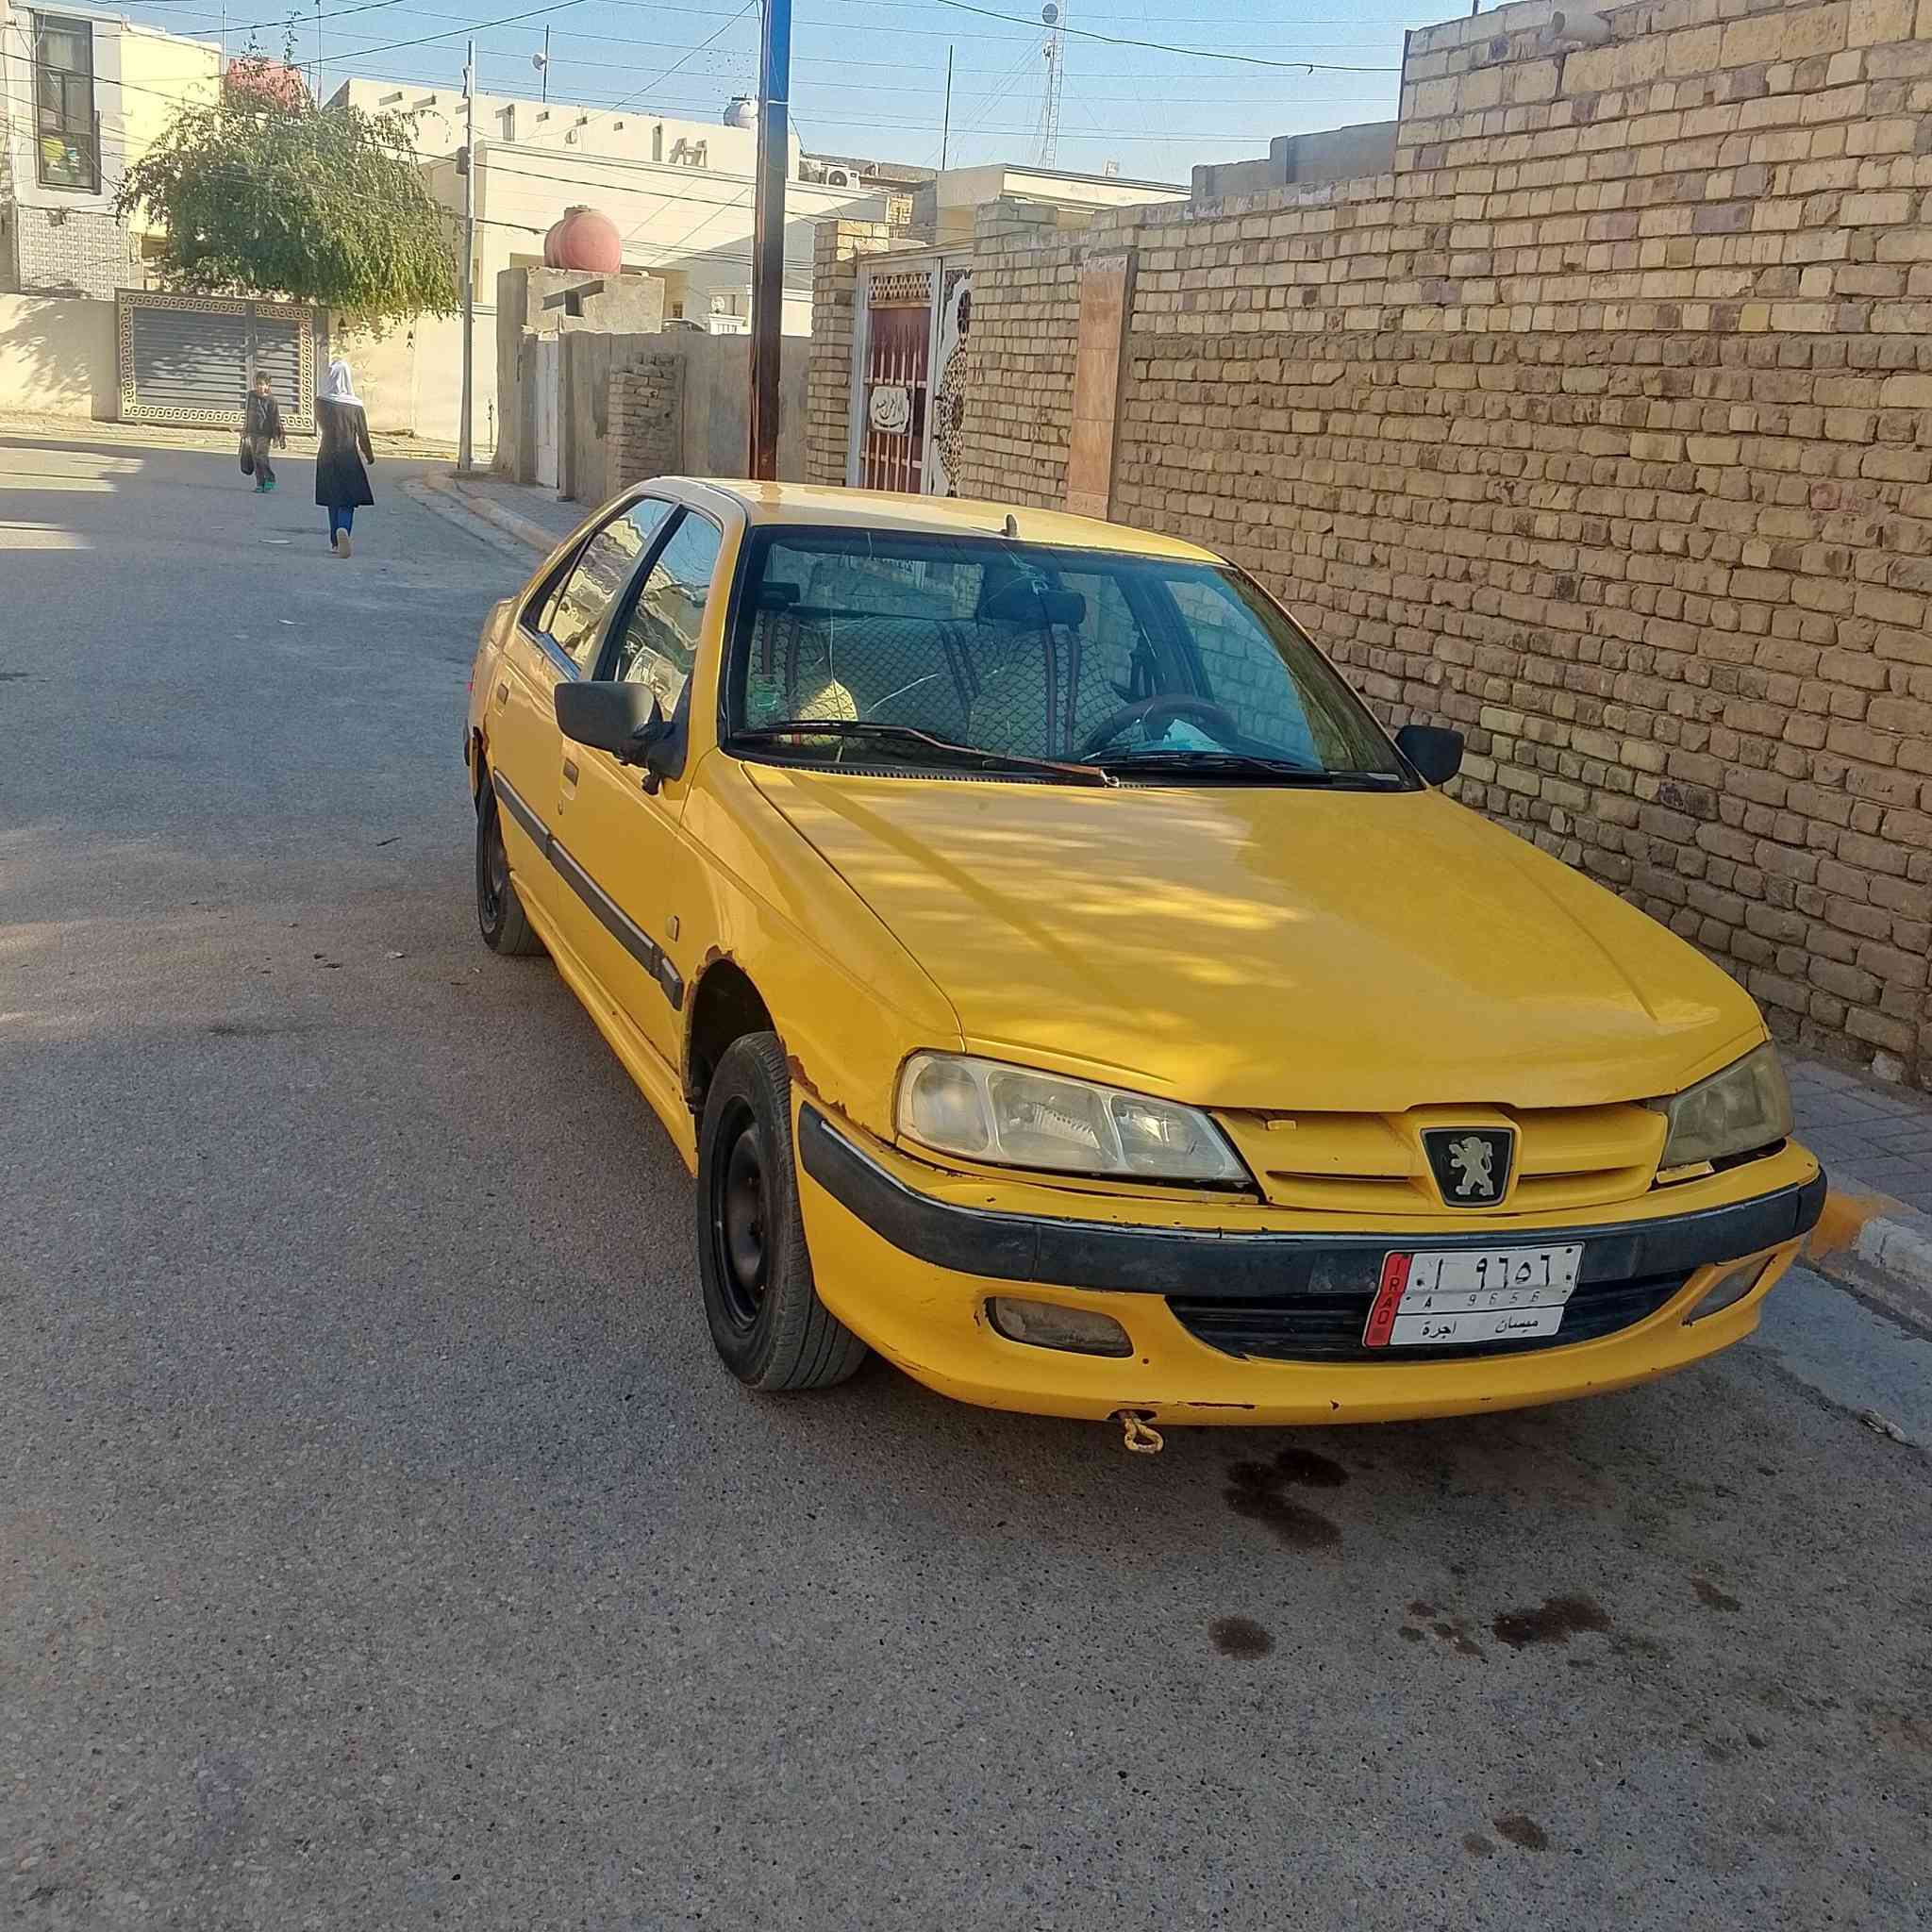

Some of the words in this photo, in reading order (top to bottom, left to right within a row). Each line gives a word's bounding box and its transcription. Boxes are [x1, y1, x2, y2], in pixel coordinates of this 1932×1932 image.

[1475, 1254, 1551, 1291] ٩٦٥٦
[1423, 1295, 1432, 1309] A
[1467, 1291, 1541, 1307] 9656
[1422, 1320, 1457, 1339] اجرة
[1494, 1314, 1540, 1334] ميسان
